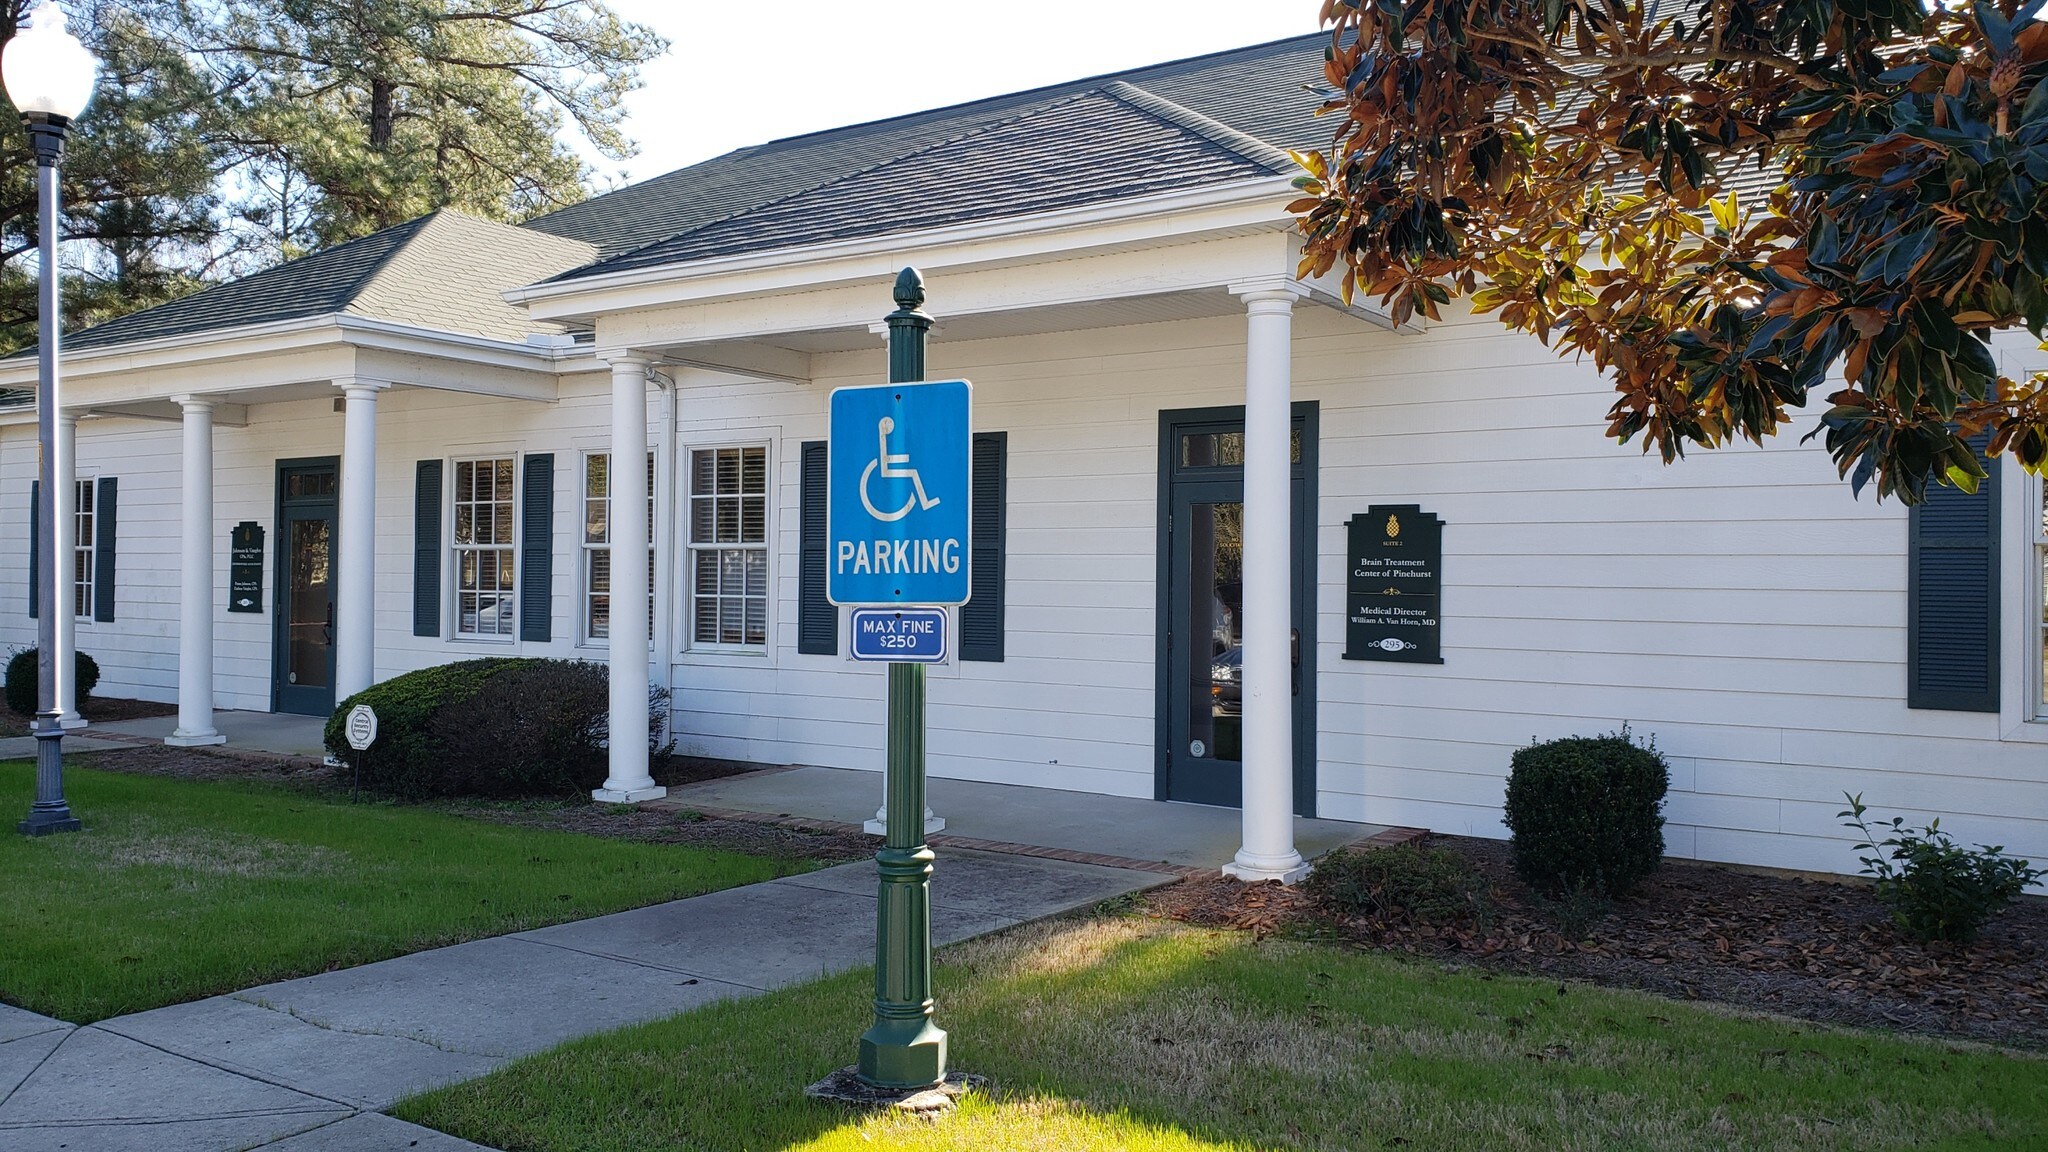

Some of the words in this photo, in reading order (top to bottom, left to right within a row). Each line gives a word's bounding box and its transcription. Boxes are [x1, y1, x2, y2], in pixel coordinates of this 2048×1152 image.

[838, 538, 960, 574] PARKING
[1361, 558, 1382, 566] Brain
[1384, 558, 1425, 566] Treatment
[1393, 570, 1432, 578] Pinehurst
[1360, 606, 1392, 615] Medical
[864, 621, 896, 633] MAX
[902, 620, 934, 634] FINE
[880, 635, 917, 648] $250
